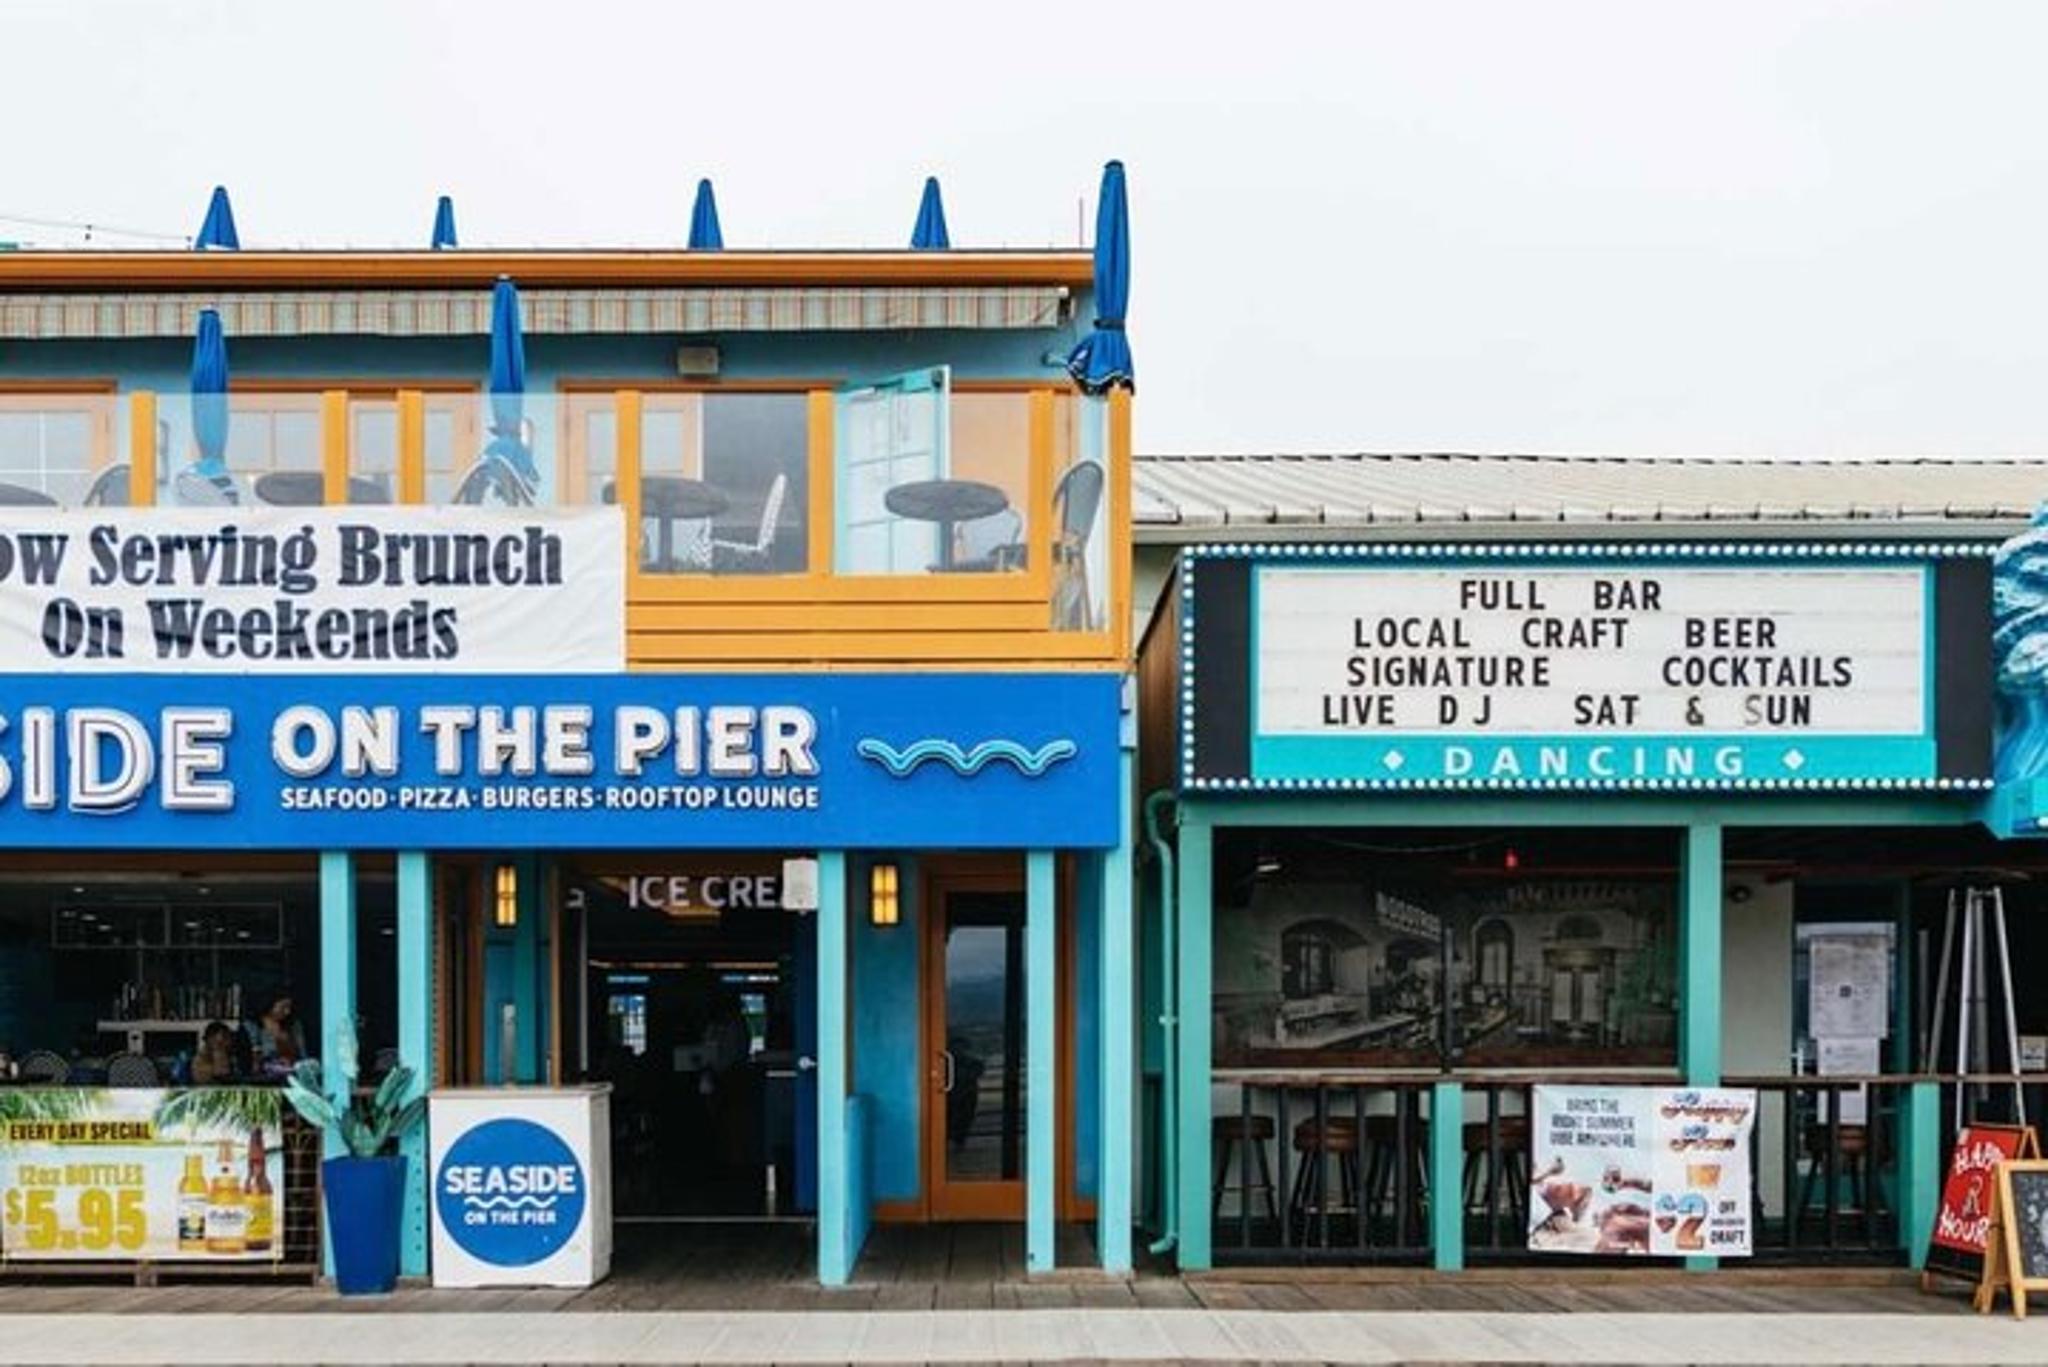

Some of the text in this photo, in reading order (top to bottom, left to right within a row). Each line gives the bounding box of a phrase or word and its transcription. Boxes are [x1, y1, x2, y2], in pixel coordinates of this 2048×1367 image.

[89, 525, 318, 595] Serving
[337, 525, 563, 586] Brunch
[1460, 580, 1661, 610] FULL BAR
[42, 597, 459, 660] On Weekends
[1354, 617, 1776, 648] LOCAL CRAFT BEER
[1347, 656, 1852, 687] SIGNATURE COCKTAILS
[1323, 694, 1395, 725] LIVE
[1574, 694, 1640, 725] SAT
[1685, 695, 1704, 725] &
[1744, 694, 1810, 725] SUN
[0, 705, 820, 812] IDE ON THE PIER
[1443, 746, 1743, 776] DANCING
[281, 787, 819, 808] SEAFOOD PIZZA BURGERS ROOFTOP LOUNGE
[628, 876, 784, 908] ICE CRE
[10, 1122, 152, 1140] EVERY DAY SPECIAL
[445, 1165, 576, 1194] SEASIDE
[464, 1210, 556, 1225] ON THE PIER
